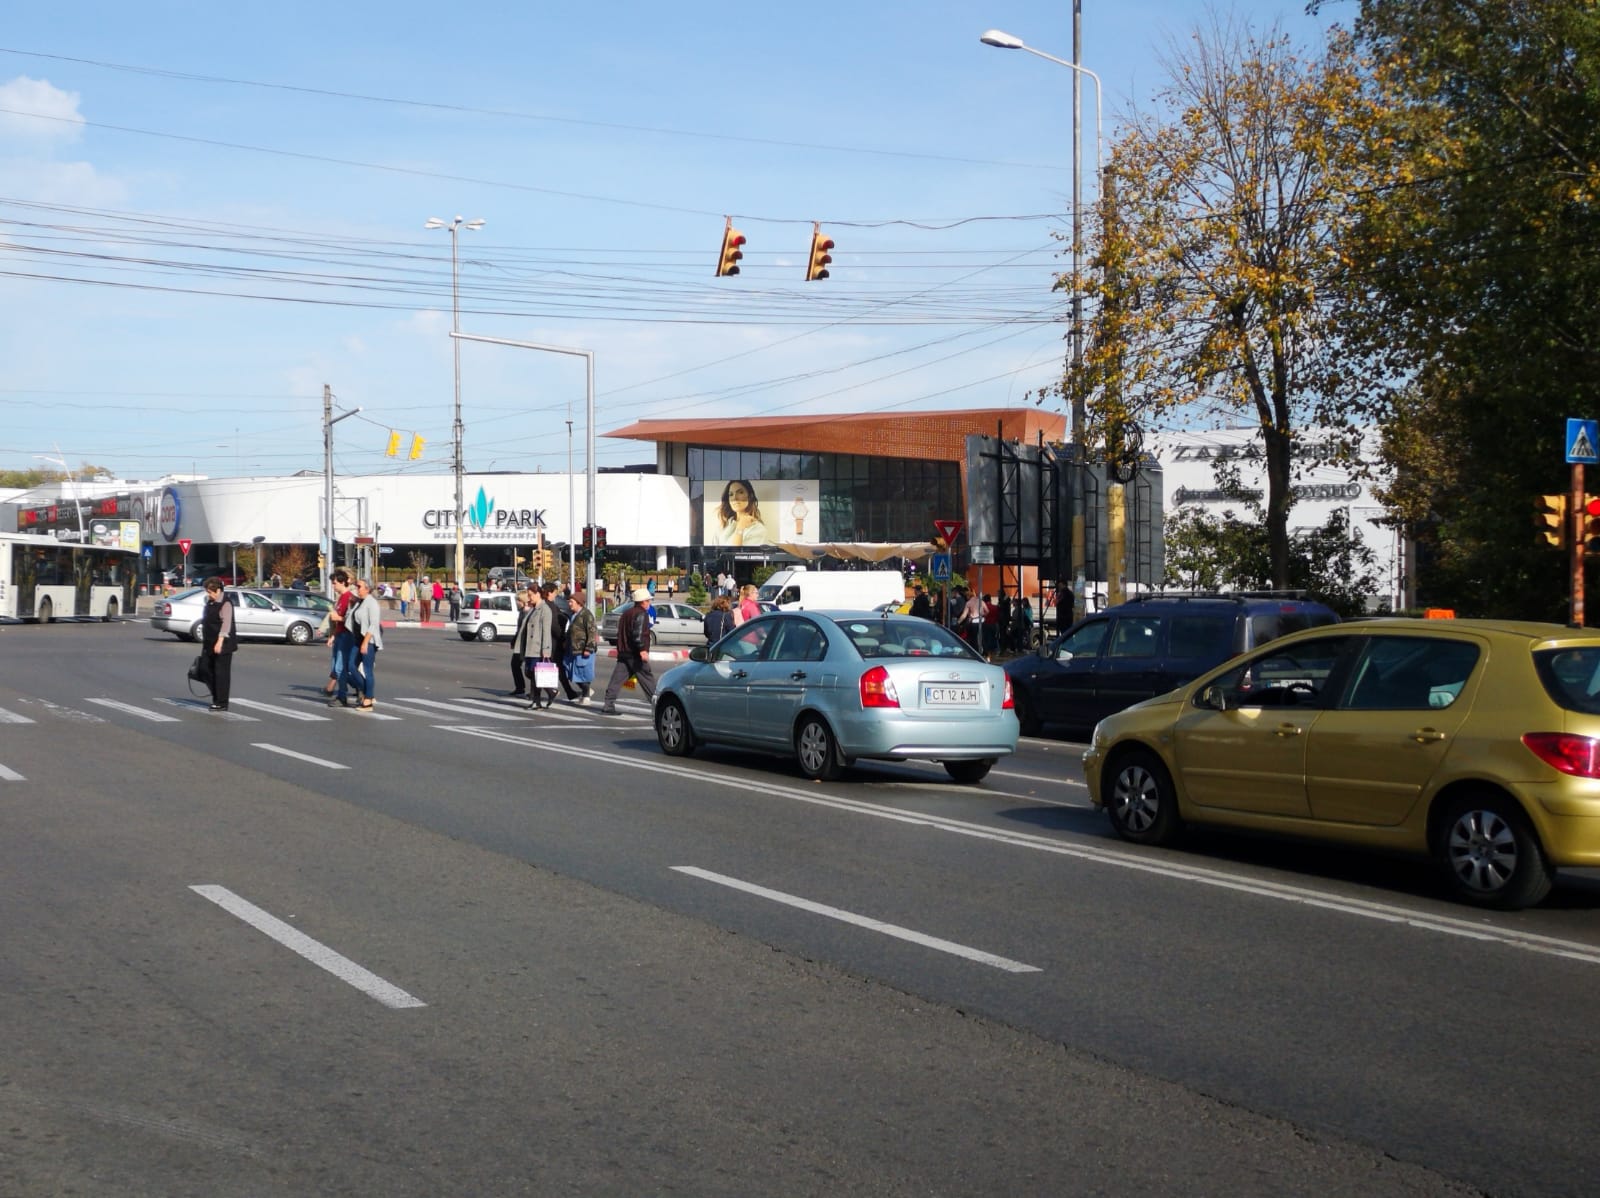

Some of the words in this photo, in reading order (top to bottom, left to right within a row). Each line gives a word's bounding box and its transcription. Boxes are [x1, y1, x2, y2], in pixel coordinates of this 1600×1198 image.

[496, 509, 546, 527] PARK
[933, 690, 944, 701] CT
[948, 690, 957, 701] 12
[961, 690, 977, 701] AJH
